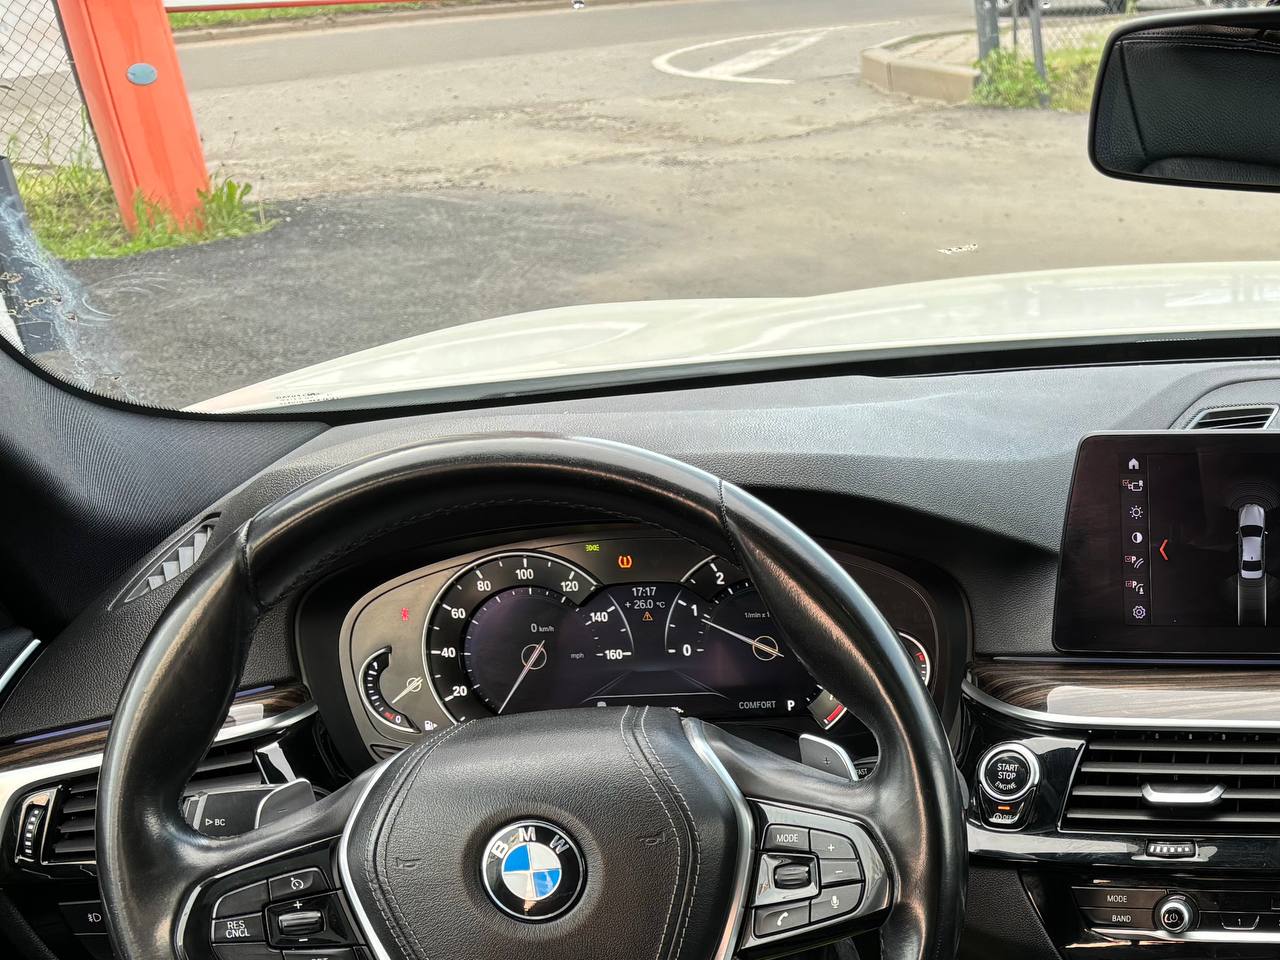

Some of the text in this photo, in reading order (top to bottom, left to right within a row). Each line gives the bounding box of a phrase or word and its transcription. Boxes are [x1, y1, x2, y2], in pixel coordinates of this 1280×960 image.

[515, 569, 534, 580] 100
[715, 571, 725, 585] 2
[477, 580, 491, 591] 80
[561, 581, 579, 592] 120
[631, 587, 657, 597] 17:17
[634, 600, 654, 609] 26.0
[451, 608, 466, 619] 60
[691, 604, 698, 616] 1
[590, 611, 609, 622] 140
[530, 623, 555, 632] 0 km/h
[441, 647, 456, 658] 40
[604, 650, 623, 660] 160
[682, 644, 692, 656] 0
[570, 652, 585, 660] mph
[452, 686, 468, 696] 20
[738, 700, 796, 711] COMFORT P
[997, 763, 1019, 772] START
[998, 771, 1017, 780] STOP
[994, 780, 1017, 791] ENGINE
[491, 826, 569, 859] BMW
[776, 833, 799, 843] MODE
[1106, 894, 1128, 903] MODE
[1111, 914, 1132, 923] BAND
[1237, 918, 1242, 926] 1
[227, 920, 245, 929] RES
[225, 928, 250, 938] CNCL
